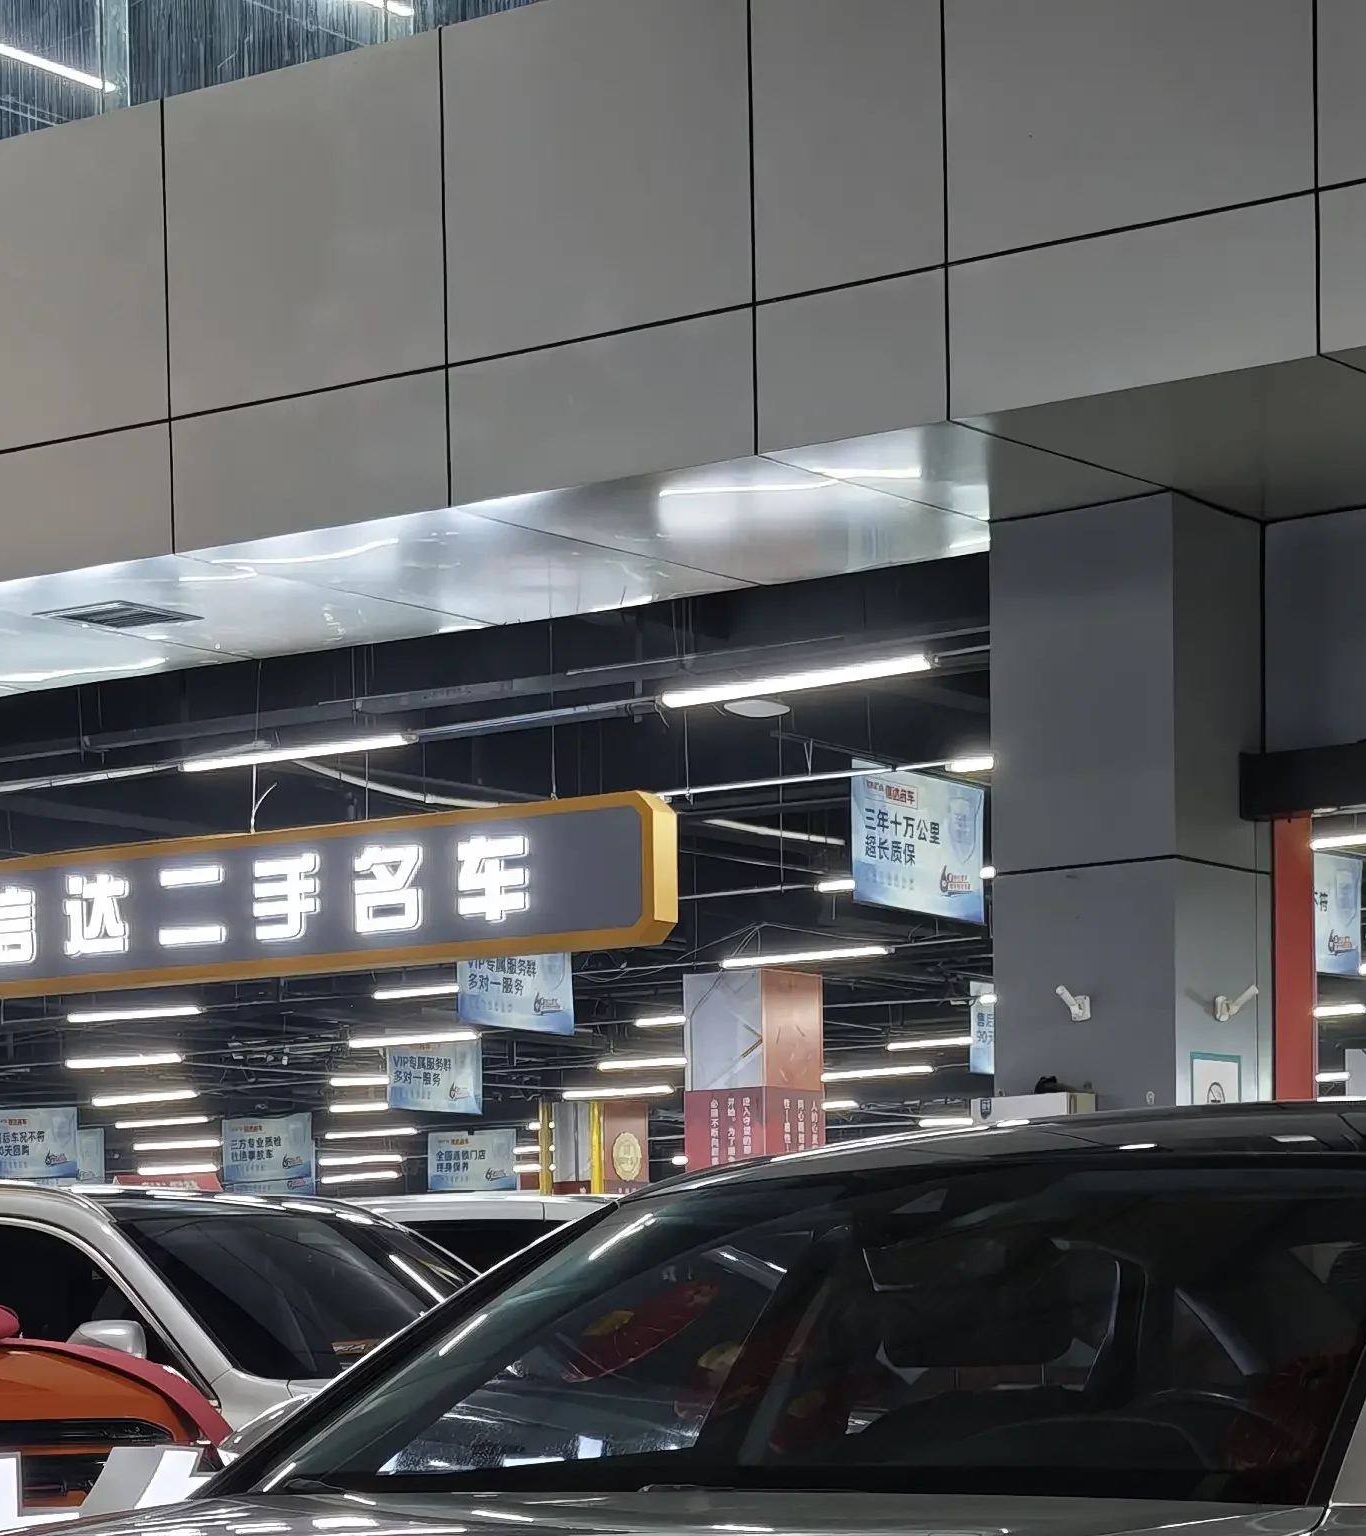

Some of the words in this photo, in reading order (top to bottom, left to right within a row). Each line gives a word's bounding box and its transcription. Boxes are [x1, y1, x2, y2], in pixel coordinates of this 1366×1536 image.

[864, 807, 941, 846] 三年十万公里
[864, 834, 916, 867] 超长质保
